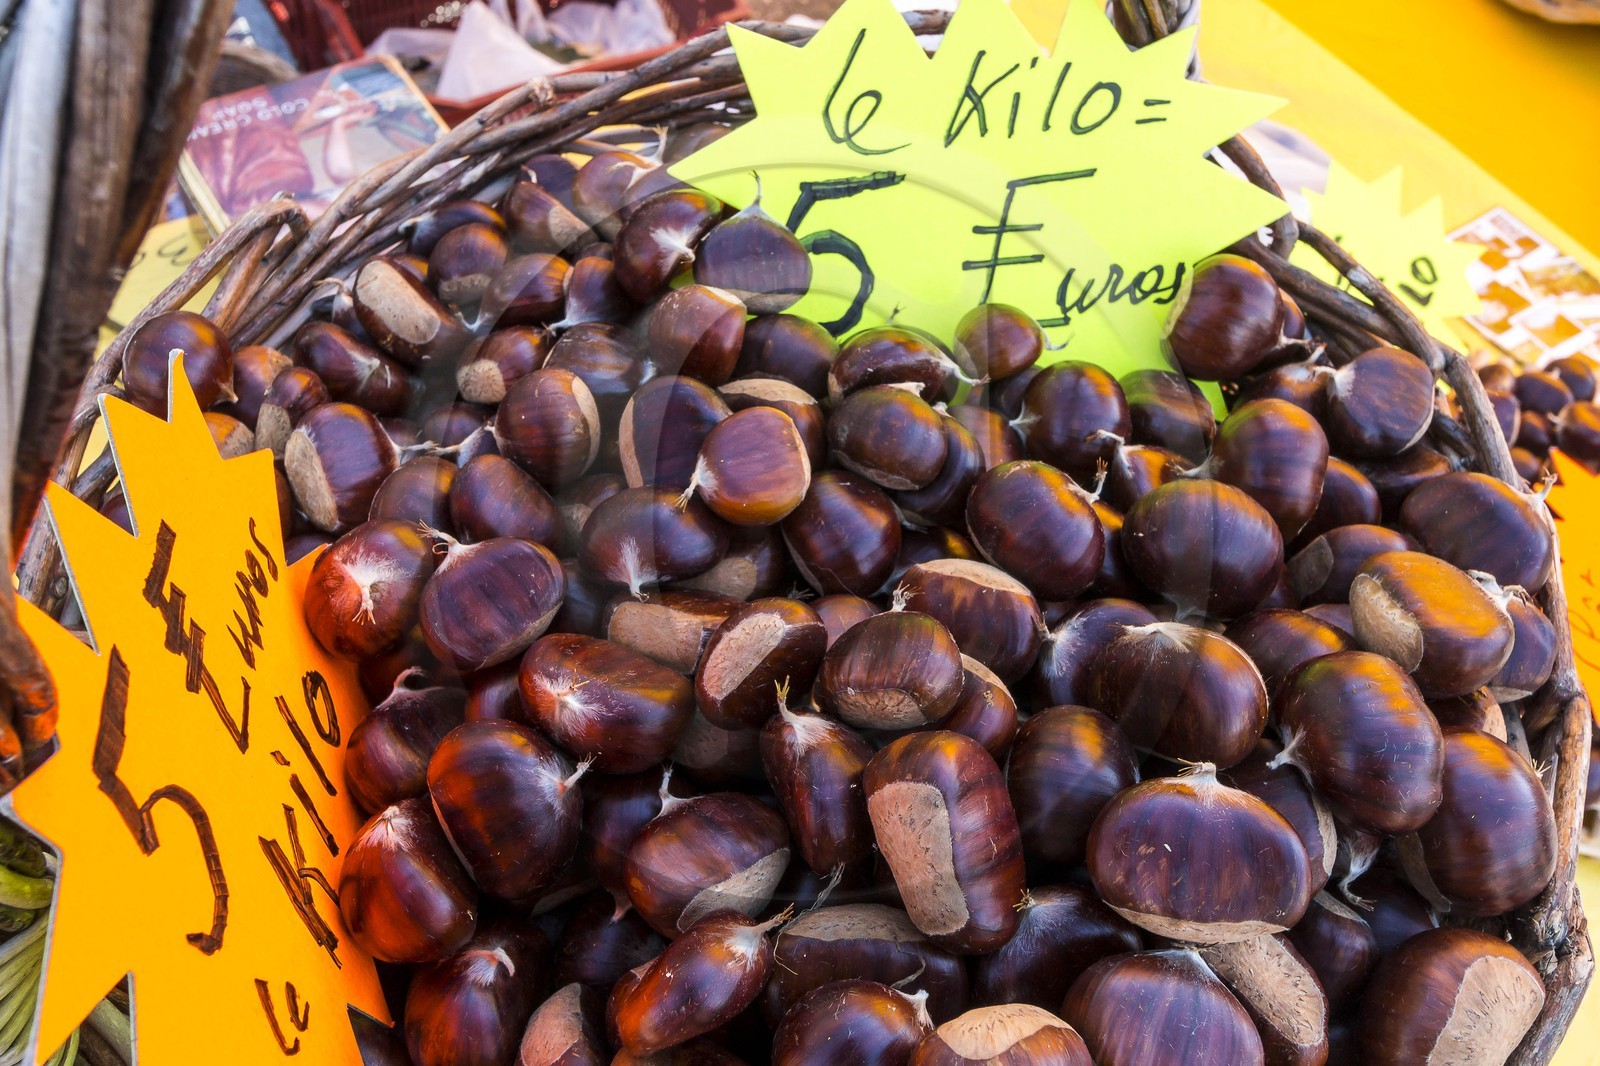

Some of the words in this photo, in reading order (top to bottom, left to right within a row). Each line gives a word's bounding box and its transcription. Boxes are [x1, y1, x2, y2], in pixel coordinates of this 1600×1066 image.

[257, 97, 310, 121] COLD
[822, 28, 912, 156] 6
[786, 170, 906, 338] 5
[962, 168, 1187, 329] Euros
[92, 644, 230, 956] 5
